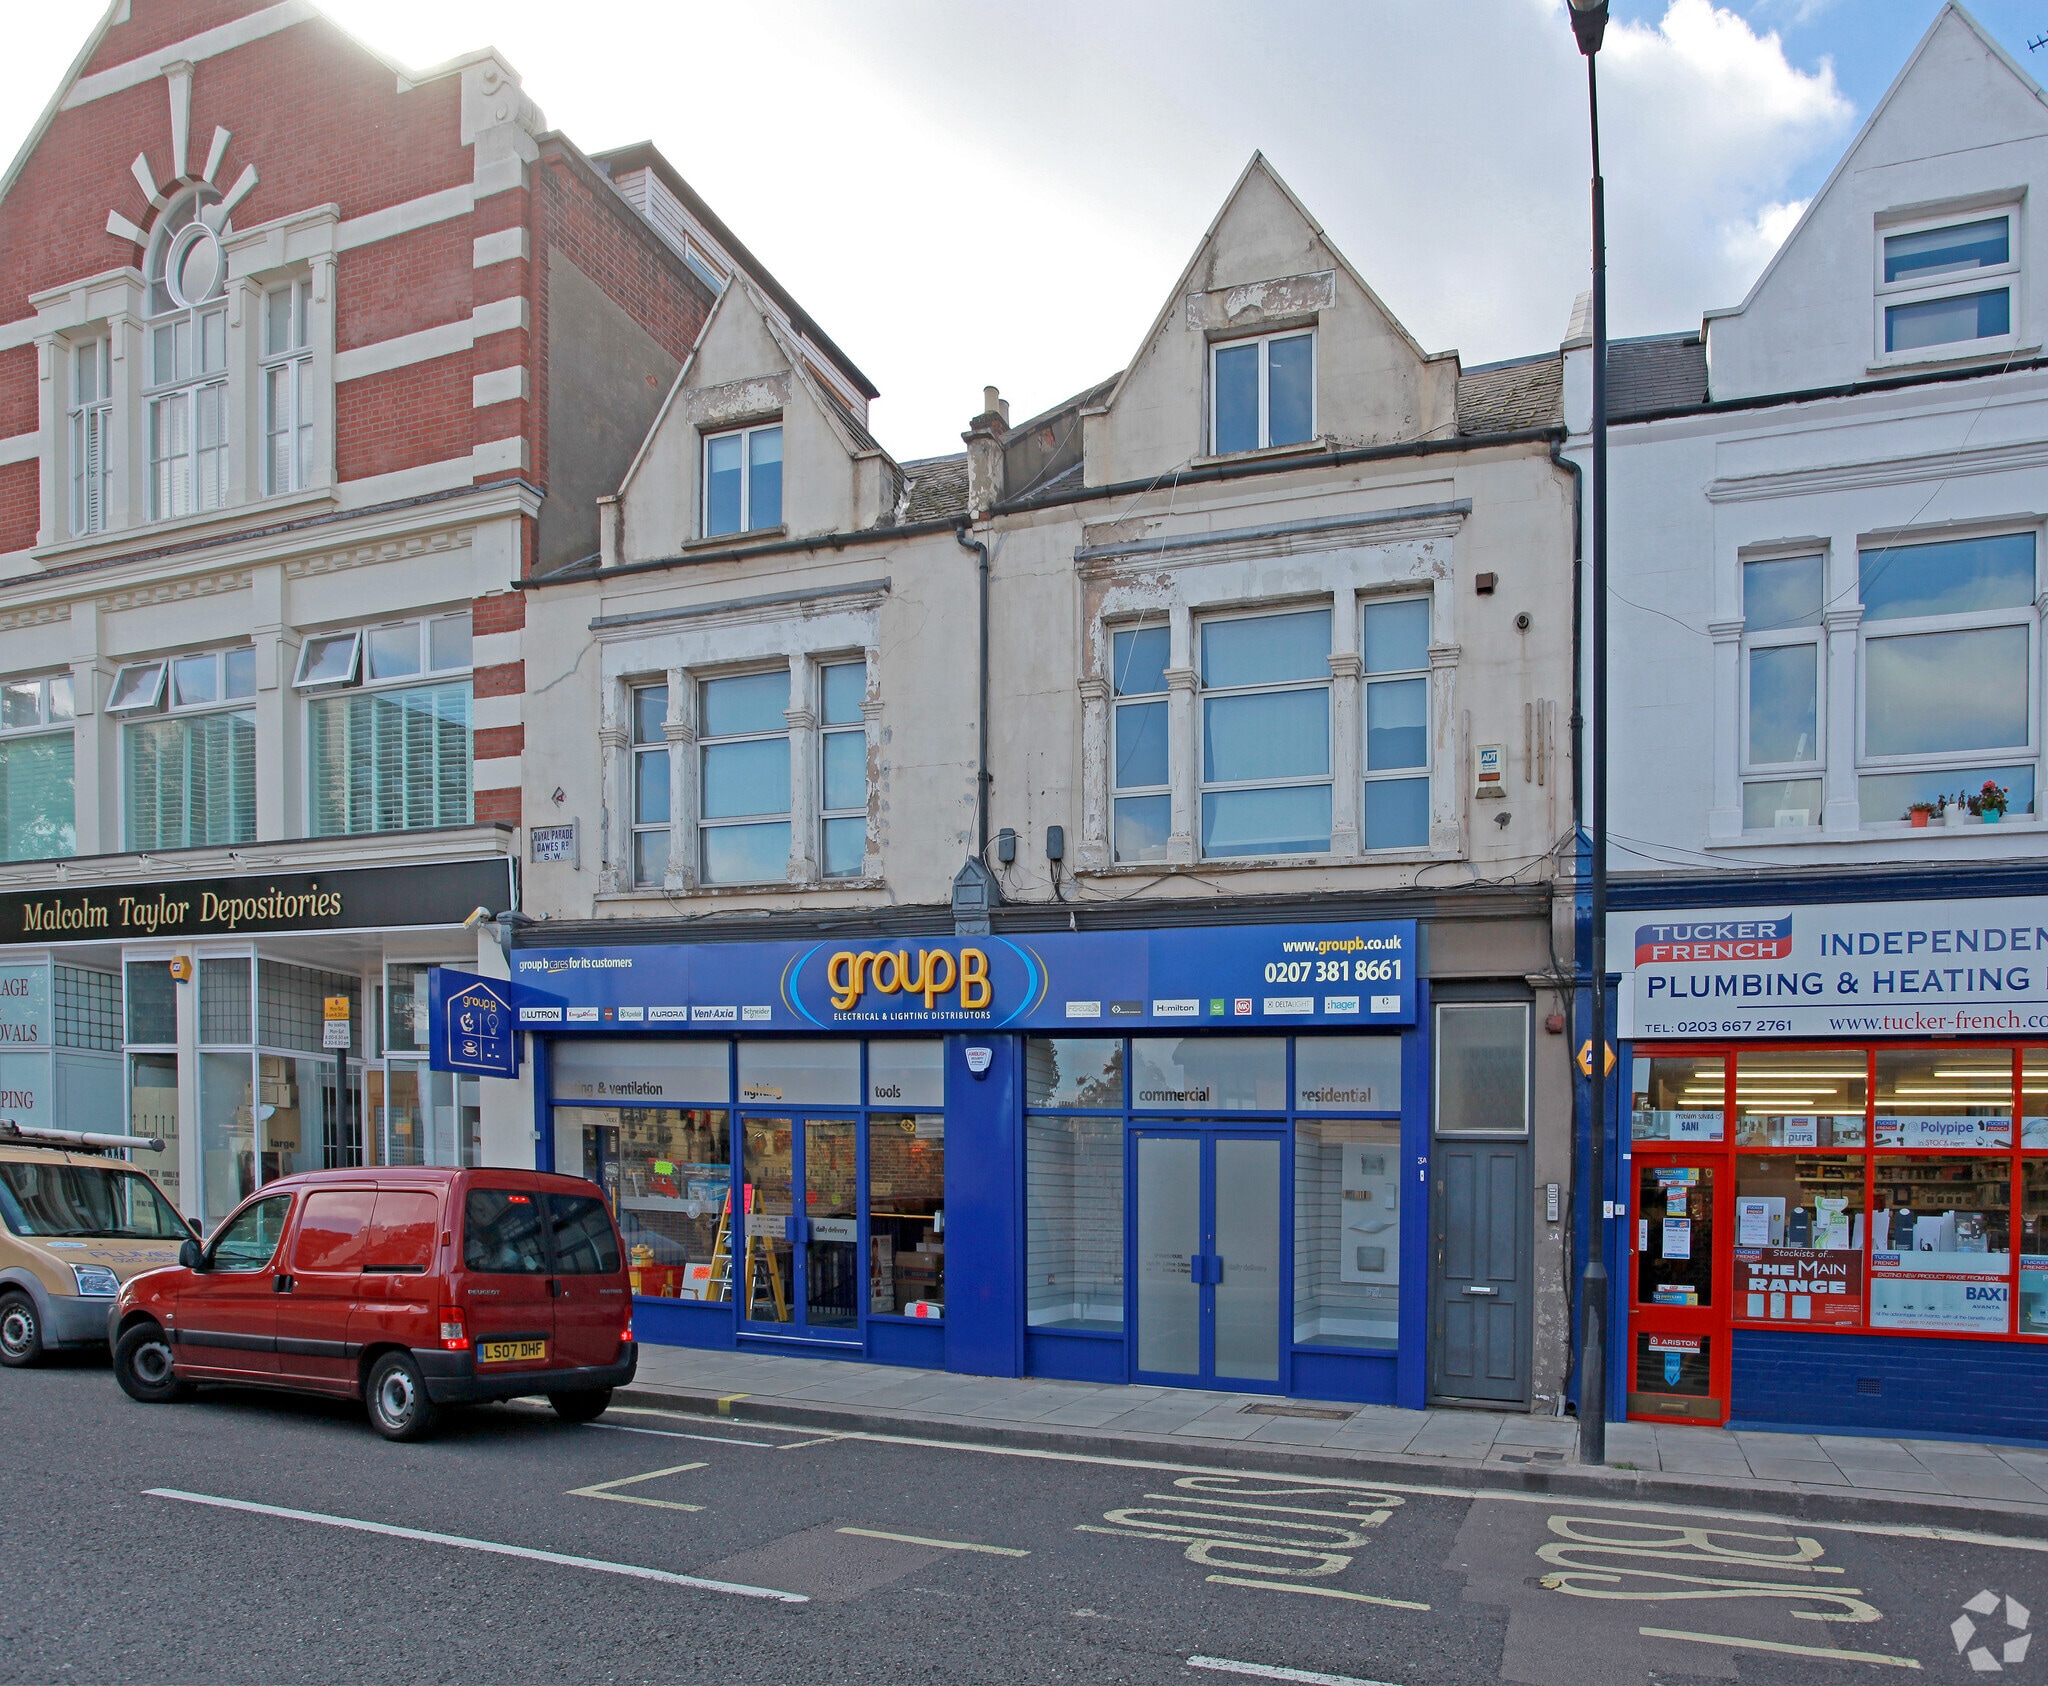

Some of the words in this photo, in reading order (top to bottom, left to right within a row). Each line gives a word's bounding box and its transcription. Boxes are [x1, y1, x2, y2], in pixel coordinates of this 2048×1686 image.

[1482, 752, 1497, 761] ADT
[533, 831, 550, 841] ROYAL
[551, 829, 573, 840] PARADE
[536, 842, 559, 852] DAWES
[544, 852, 563, 861] S.W.
[23, 898, 109, 931] Malcolm
[119, 893, 190, 933] Taylor
[200, 883, 342, 929] Depositories
[1652, 922, 1777, 942] TUCKER
[1283, 935, 1401, 955] www.groupb.co.uk
[1652, 941, 1778, 961] FRENCH
[519, 958, 543, 972] group
[543, 958, 549, 969] b
[550, 959, 569, 969] cares
[569, 958, 581, 969] for
[581, 958, 590, 969] its
[591, 957, 633, 968] customers
[1264, 961, 1312, 983] 0207
[1315, 961, 1349, 982] 381
[1354, 959, 1401, 981] 8661
[0, 979, 29, 996] AGE
[1647, 972, 1824, 999] PLUMBING
[1837, 971, 1859, 995] &
[1872, 966, 2030, 994] HEATING
[1330, 1000, 1356, 1011] hager
[1382, 997, 1389, 1005] C
[526, 1010, 559, 1019] LUTRON
[650, 1010, 684, 1018] AURORA
[694, 1009, 734, 1019] Vent-Axia
[744, 1007, 770, 1018] Schneider
[833, 1012, 880, 1021] ELECTRICAL
[882, 1012, 888, 1020] &
[890, 1012, 929, 1021] LIGHTING
[931, 1011, 991, 1020] DISTRIBUTORS
[1645, 1023, 1675, 1033] TEL:
[1677, 1021, 1718, 1033] 0203
[1722, 1021, 1751, 1033] 667
[1756, 1020, 1792, 1032] 2761
[1829, 1010, 2048, 1031] www.tucker-french.co
[0, 1024, 38, 1042] VALS
[598, 1082, 607, 1094] &
[609, 1081, 663, 1095] ventilation
[744, 1083, 783, 1099] lighting
[875, 1085, 901, 1098] tools
[1139, 1087, 1210, 1102] commercial
[1302, 1088, 1371, 1103] residential
[1681, 1121, 1699, 1131] SANI
[1920, 1121, 1974, 1135] Polypipe
[270, 1138, 295, 1149] large
[1789, 1134, 1813, 1144] pura
[816, 1226, 828, 1234] daily
[828, 1226, 848, 1235] delivery
[1773, 1250, 1815, 1258] Stockists
[1748, 1264, 1795, 1276] THE
[1748, 1278, 1846, 1294] RANGE
[1965, 1286, 2008, 1302] BAXI
[1661, 1339, 1698, 1347] ARISTON
[485, 1344, 518, 1359] LS07
[521, 1342, 543, 1357] DHF
[1535, 1515, 1884, 1623] BUS
